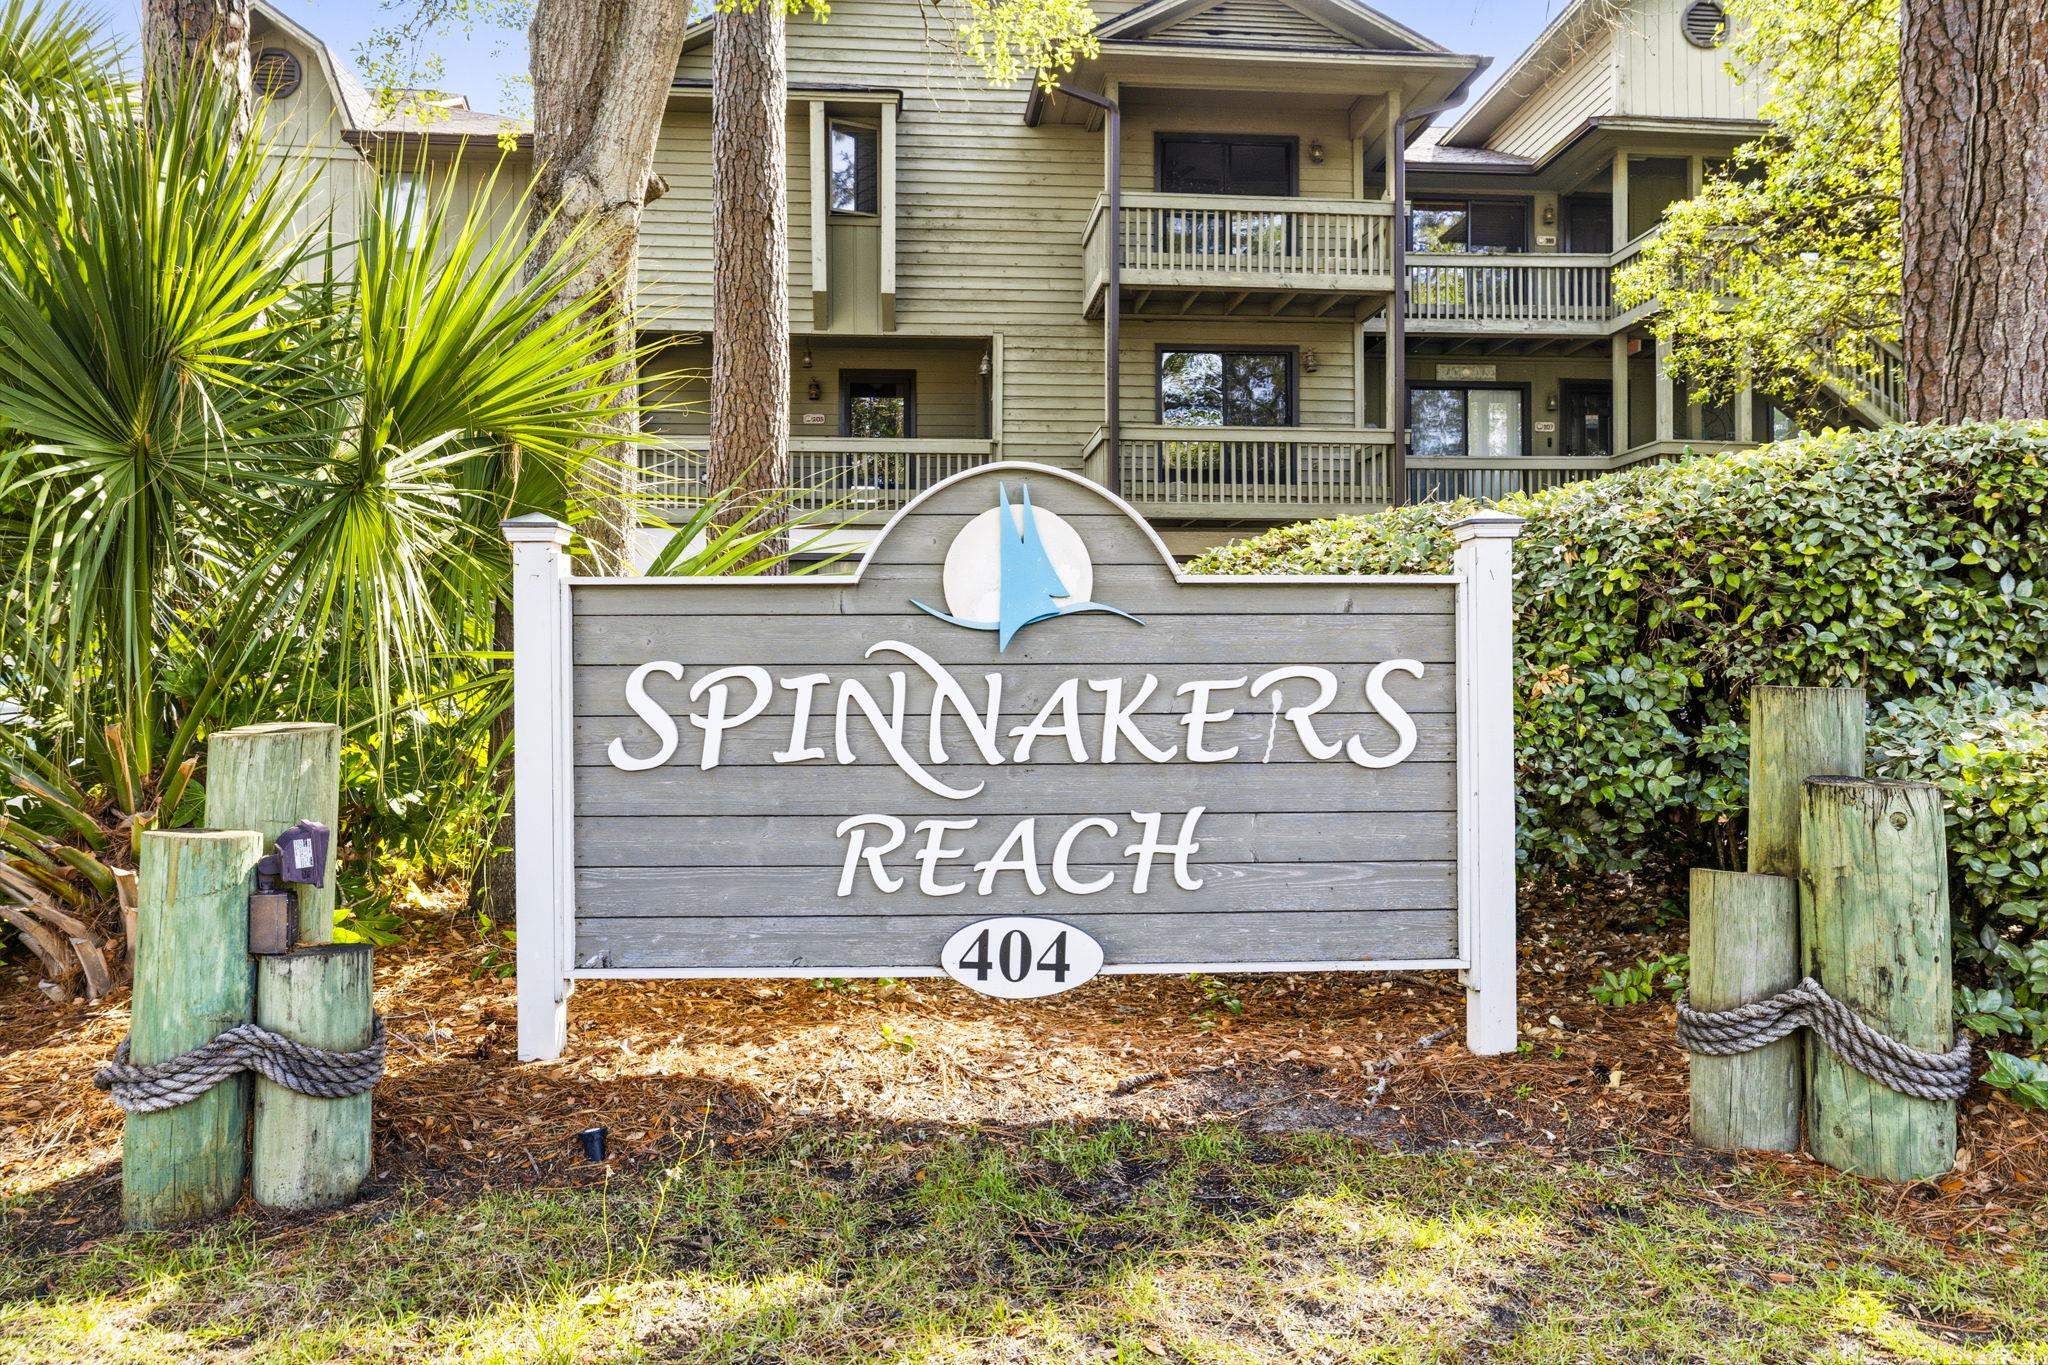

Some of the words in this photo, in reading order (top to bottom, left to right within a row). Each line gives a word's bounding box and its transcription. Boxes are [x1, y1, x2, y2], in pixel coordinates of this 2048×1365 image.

[607, 640, 1425, 800] SPINNAKERS
[837, 806, 1205, 897] REACH
[958, 928, 1071, 984] 404
